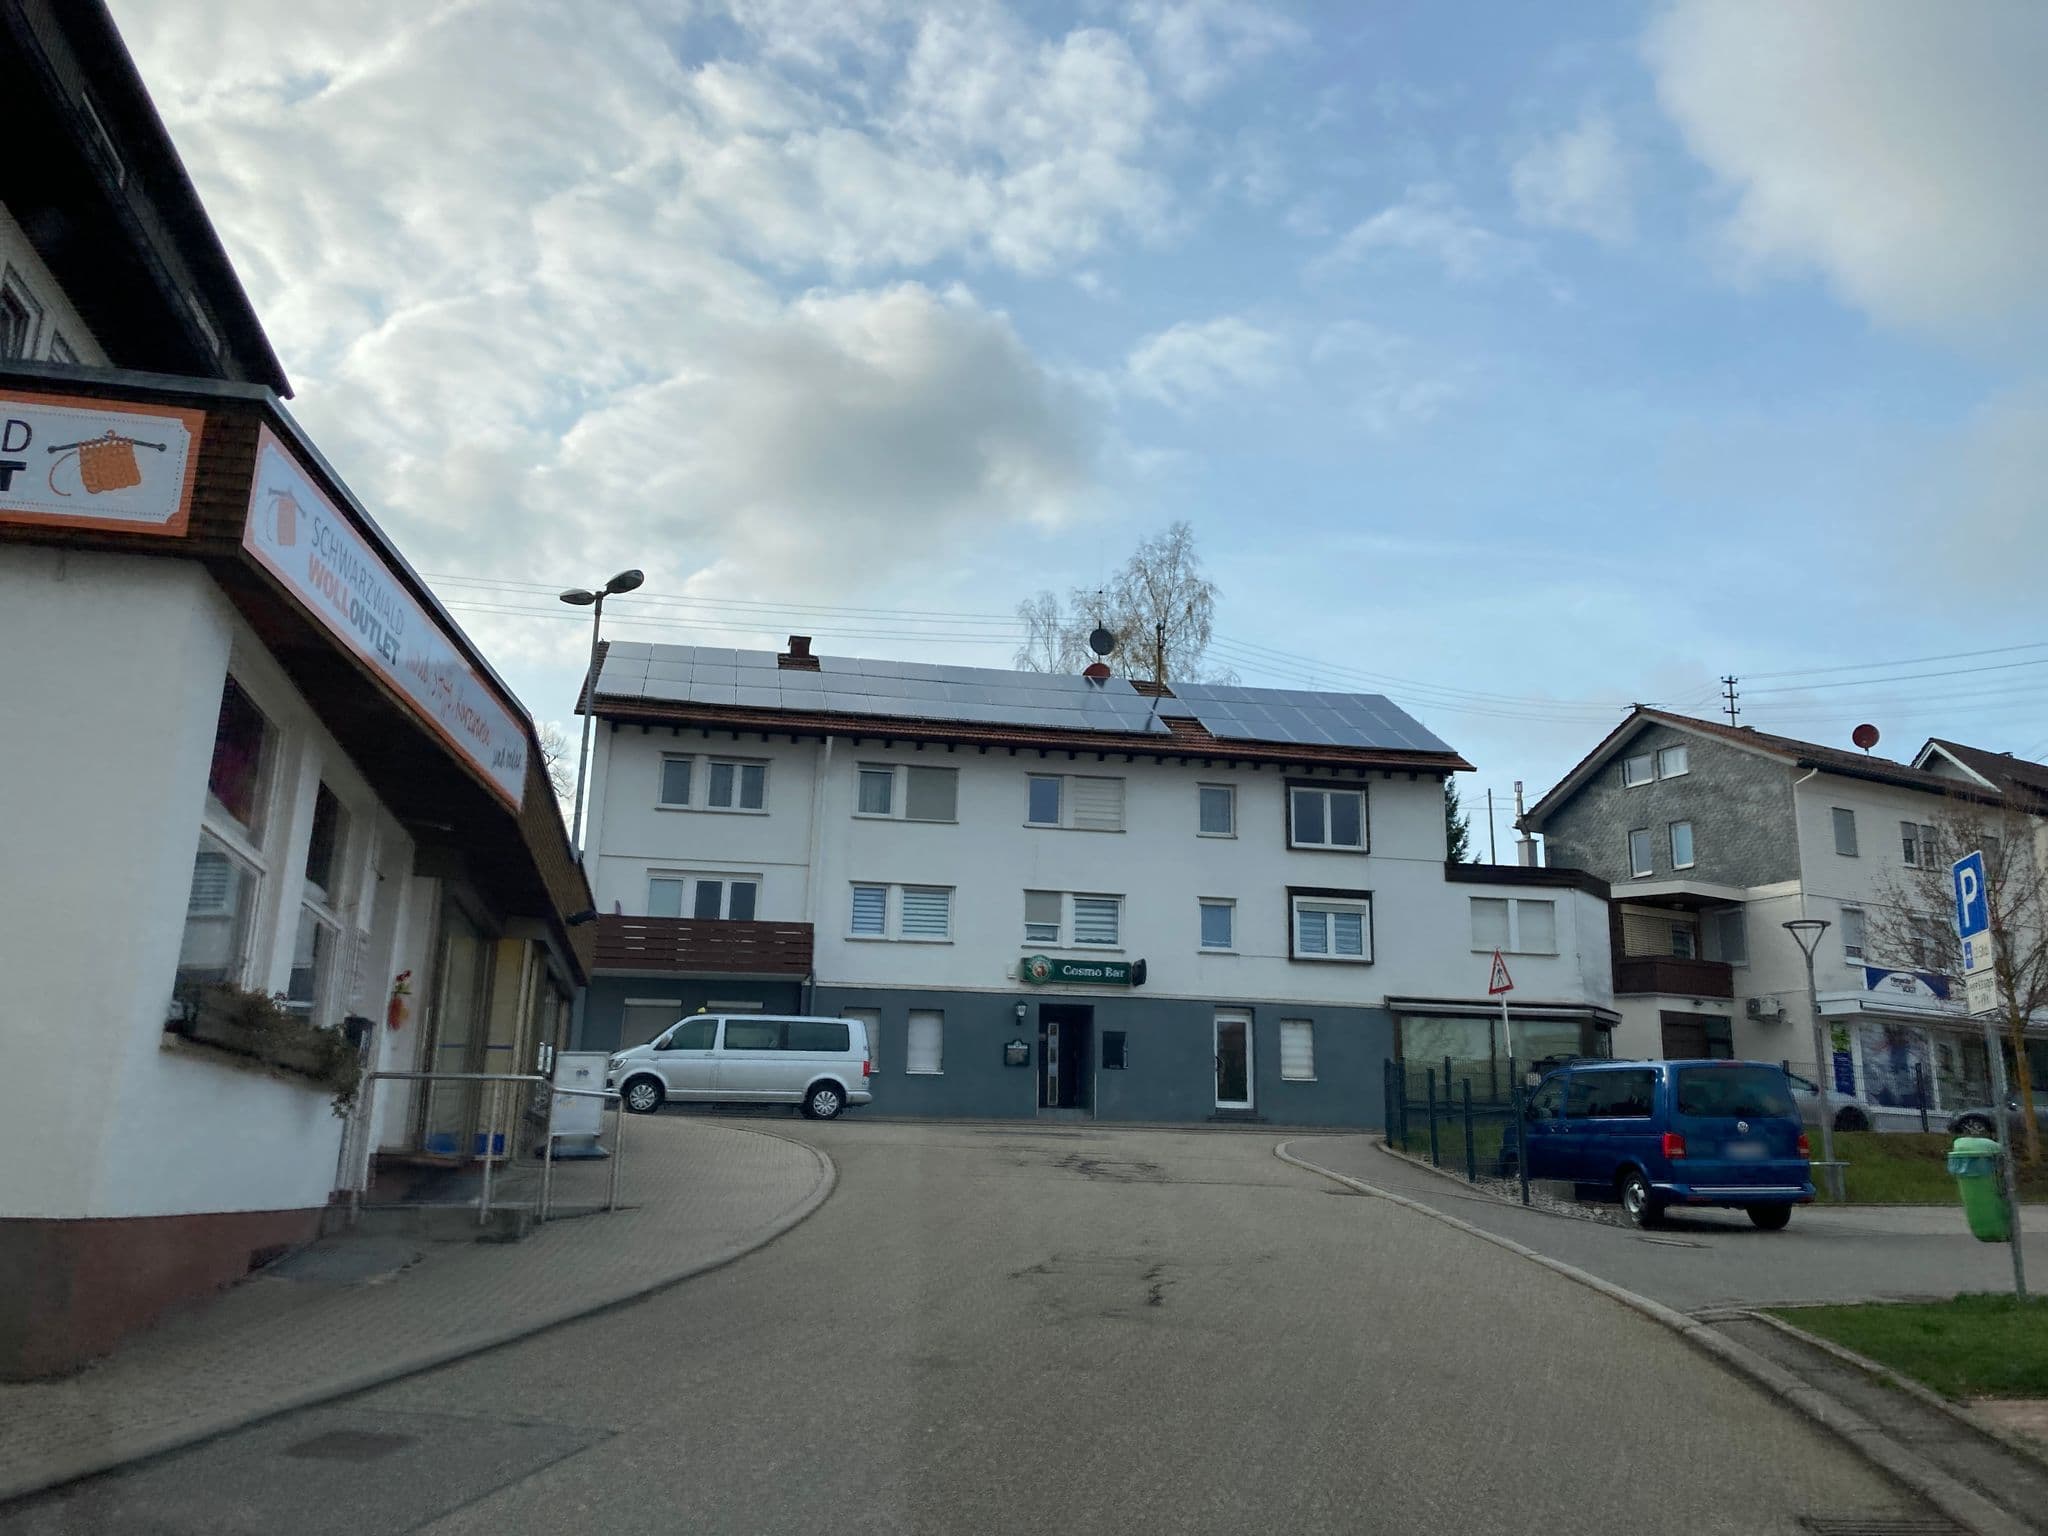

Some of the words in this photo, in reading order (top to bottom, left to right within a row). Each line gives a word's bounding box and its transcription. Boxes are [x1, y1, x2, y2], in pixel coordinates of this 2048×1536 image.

[311, 516, 405, 636] SCHWARZWALD
[1959, 867, 1977, 928] P
[1062, 965, 1102, 977] Cosmo
[1104, 967, 1126, 978] Bar
